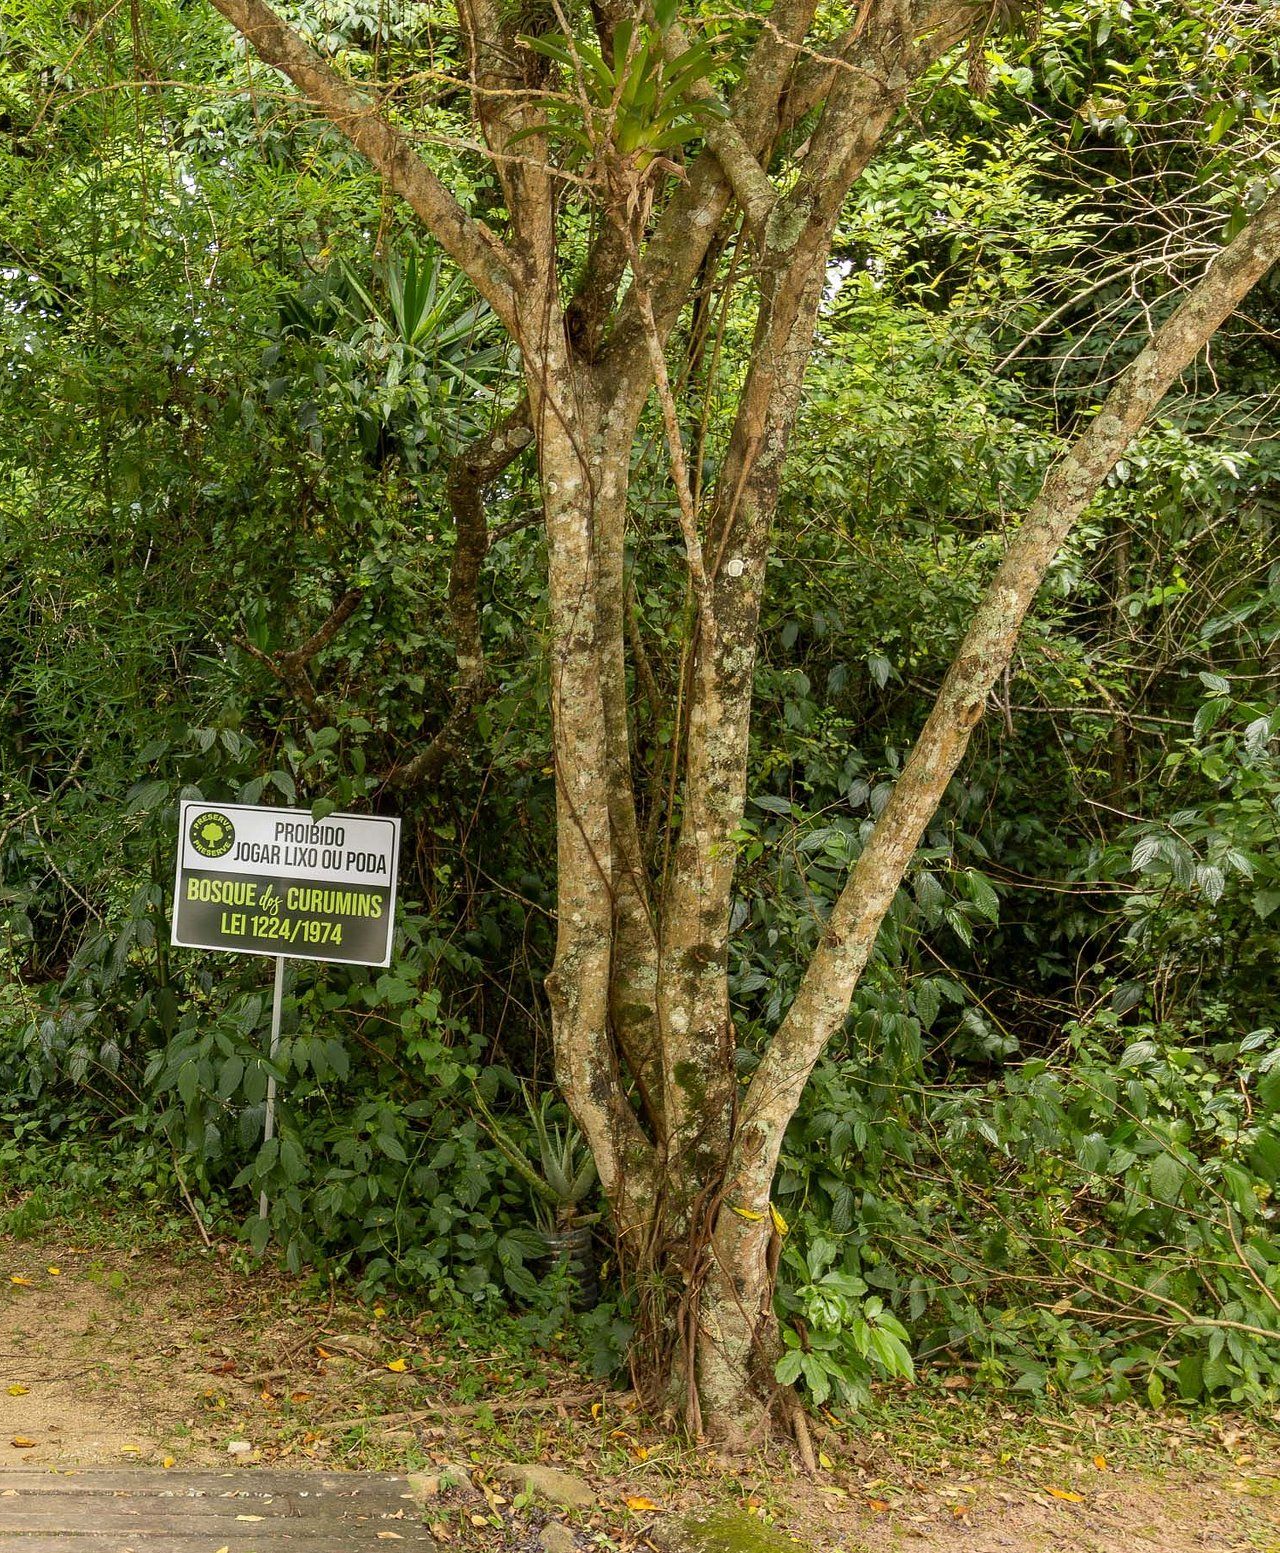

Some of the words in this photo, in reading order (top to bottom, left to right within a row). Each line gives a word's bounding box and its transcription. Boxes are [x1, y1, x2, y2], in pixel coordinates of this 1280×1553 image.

[193, 813, 233, 832] PRESERVE
[274, 822, 345, 847] PROIBIDO
[193, 839, 232, 857] PRESERVE
[233, 841, 281, 865] JOGAR
[284, 846, 318, 868] LIXO
[321, 849, 343, 870] OU
[346, 851, 387, 875] PODA
[186, 877, 257, 907] BOSQUE
[258, 884, 284, 916] dos
[287, 887, 383, 919] CURUMINS
[221, 912, 247, 936] LEI
[250, 915, 343, 945] 1224/1974
